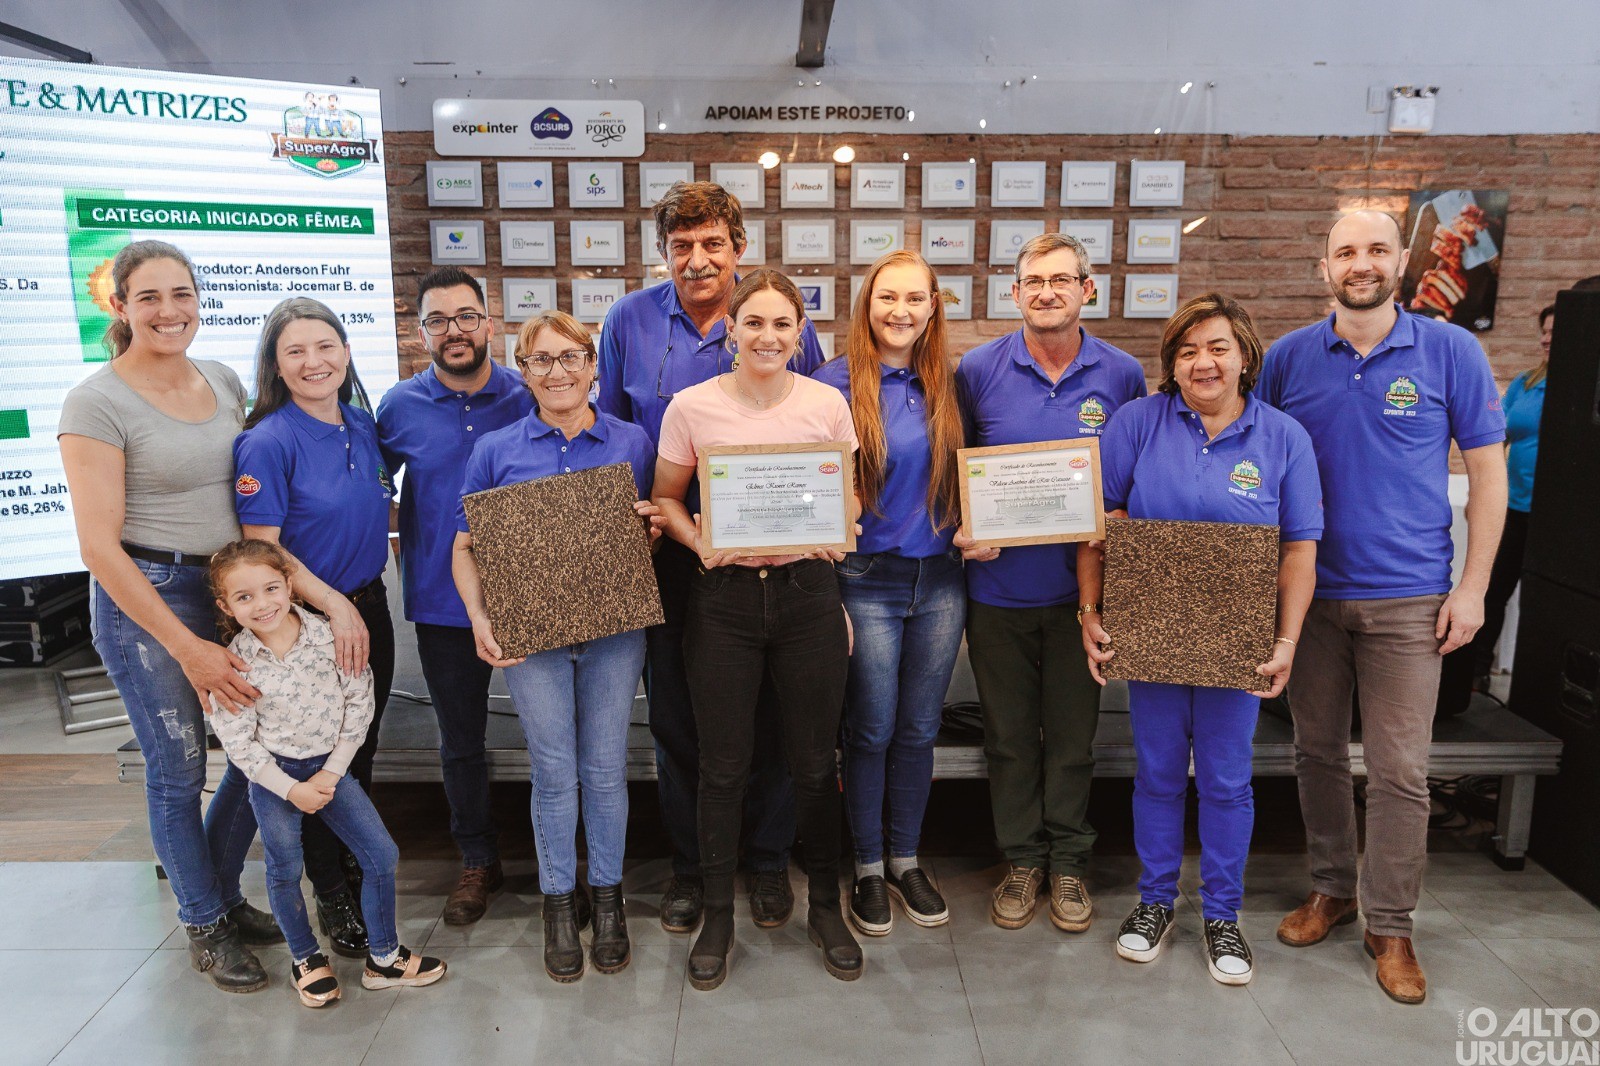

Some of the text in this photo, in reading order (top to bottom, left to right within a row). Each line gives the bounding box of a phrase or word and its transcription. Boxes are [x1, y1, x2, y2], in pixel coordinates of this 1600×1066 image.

[39, 82, 69, 109] &
[74, 85, 247, 123] MATRIZES
[705, 105, 772, 120] APOIAM
[777, 106, 820, 120] ESTE
[452, 121, 518, 136] expointer
[585, 124, 626, 136] PORCO
[285, 140, 366, 157] SuperAgro
[92, 207, 362, 230] CATEGORIA INICIADOR FÊMEA
[255, 263, 318, 275] Anderson
[322, 264, 350, 276] Fuhr
[18, 279, 38, 290] Da
[200, 279, 375, 292] xtensionista: Jocemar B. de
[200, 298, 223, 309] vila
[200, 314, 260, 326] ndicador:
[19, 485, 36, 497] M.
[236, 481, 258, 492] Seara
[12, 501, 65, 516] 96,26%
